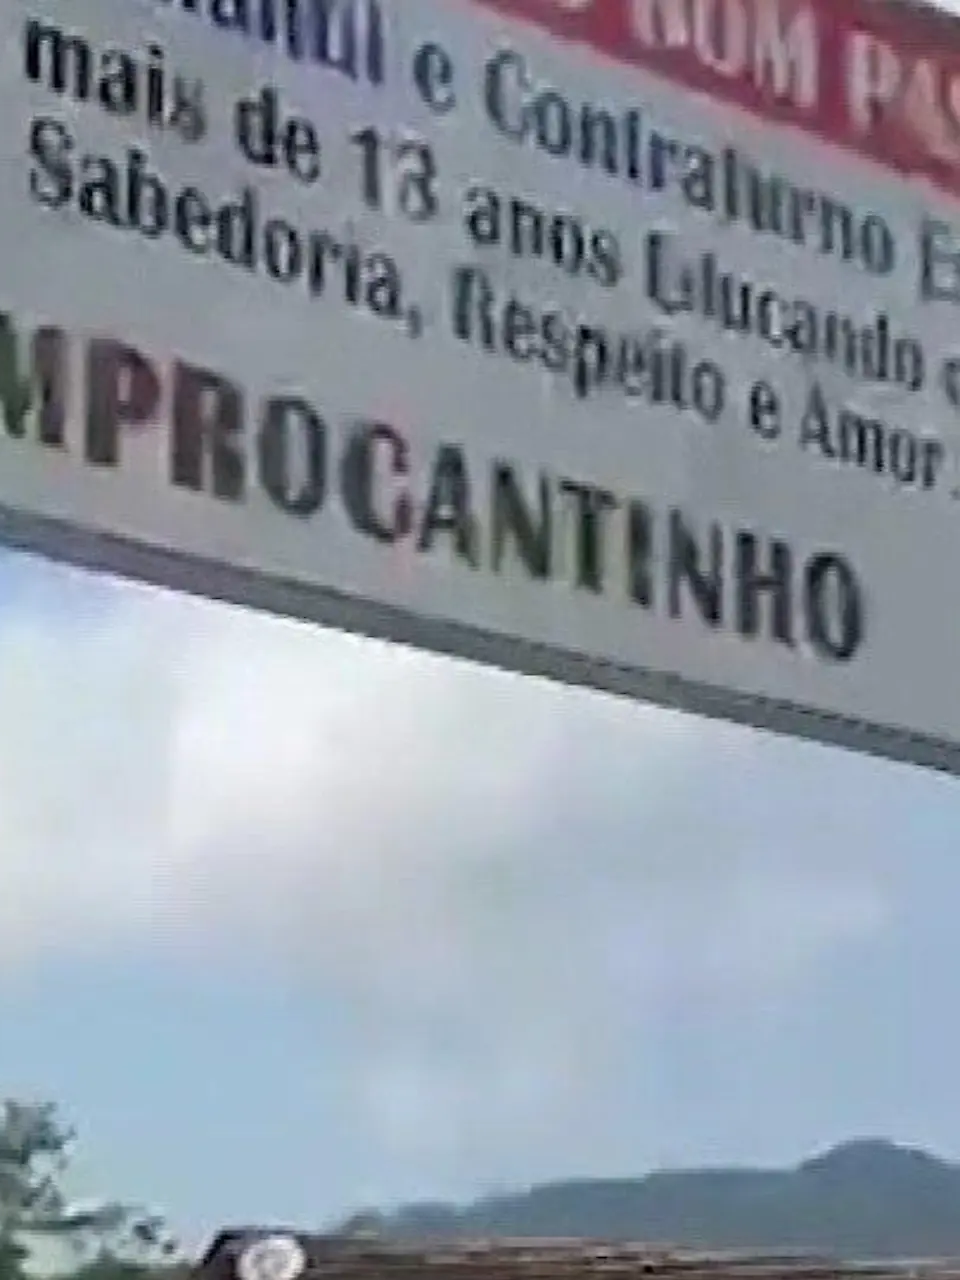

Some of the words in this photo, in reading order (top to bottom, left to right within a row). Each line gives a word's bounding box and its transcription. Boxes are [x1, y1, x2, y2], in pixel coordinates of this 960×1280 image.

[24, 14, 208, 142] mais
[234, 84, 321, 184] de
[464, 184, 622, 288] anos
[413, 40, 454, 114] e
[28, 113, 423, 340] Sabedoria,
[749, 379, 781, 440] e
